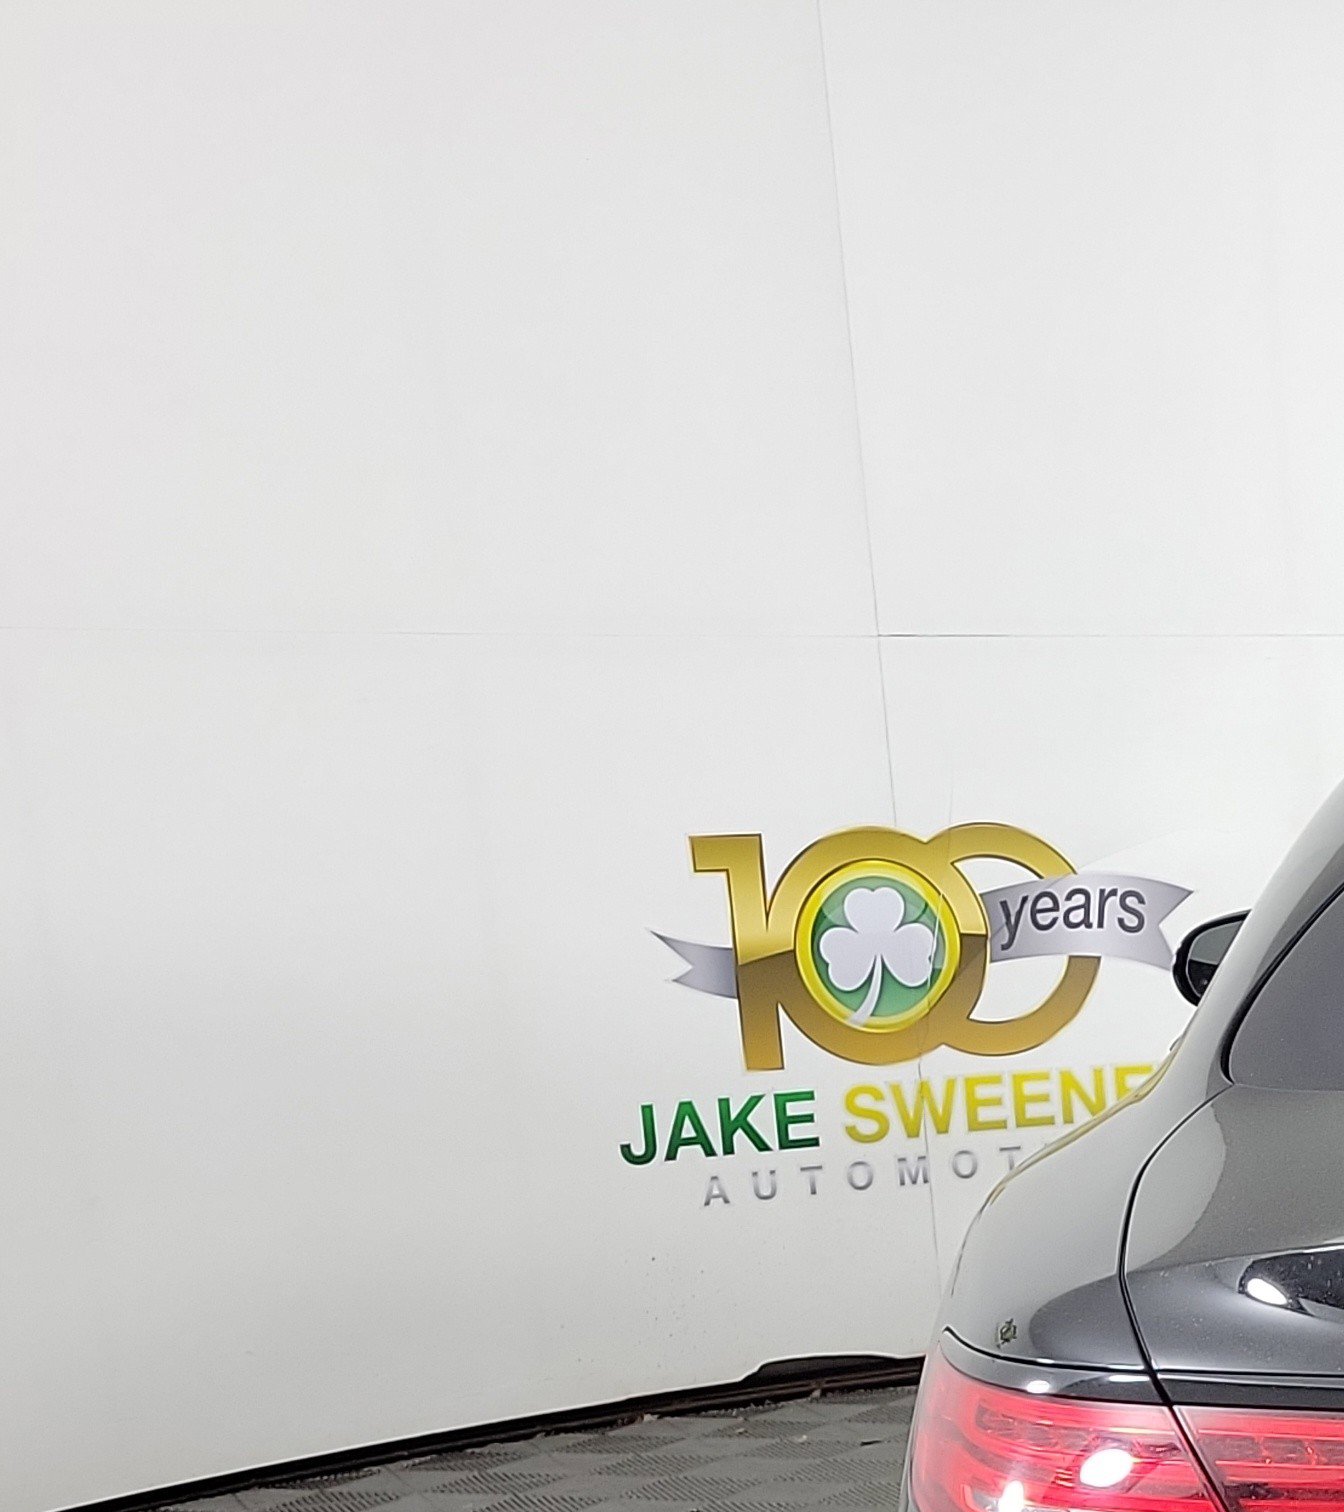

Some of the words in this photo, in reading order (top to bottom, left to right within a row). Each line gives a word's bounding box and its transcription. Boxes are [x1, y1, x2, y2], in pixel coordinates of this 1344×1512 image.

[688, 822, 1101, 1071] 100
[999, 887, 1146, 950] years
[620, 1089, 821, 1166] JAKE
[844, 1063, 1154, 1145] SWEEN
[703, 1145, 1022, 1207] AUTOMOT
